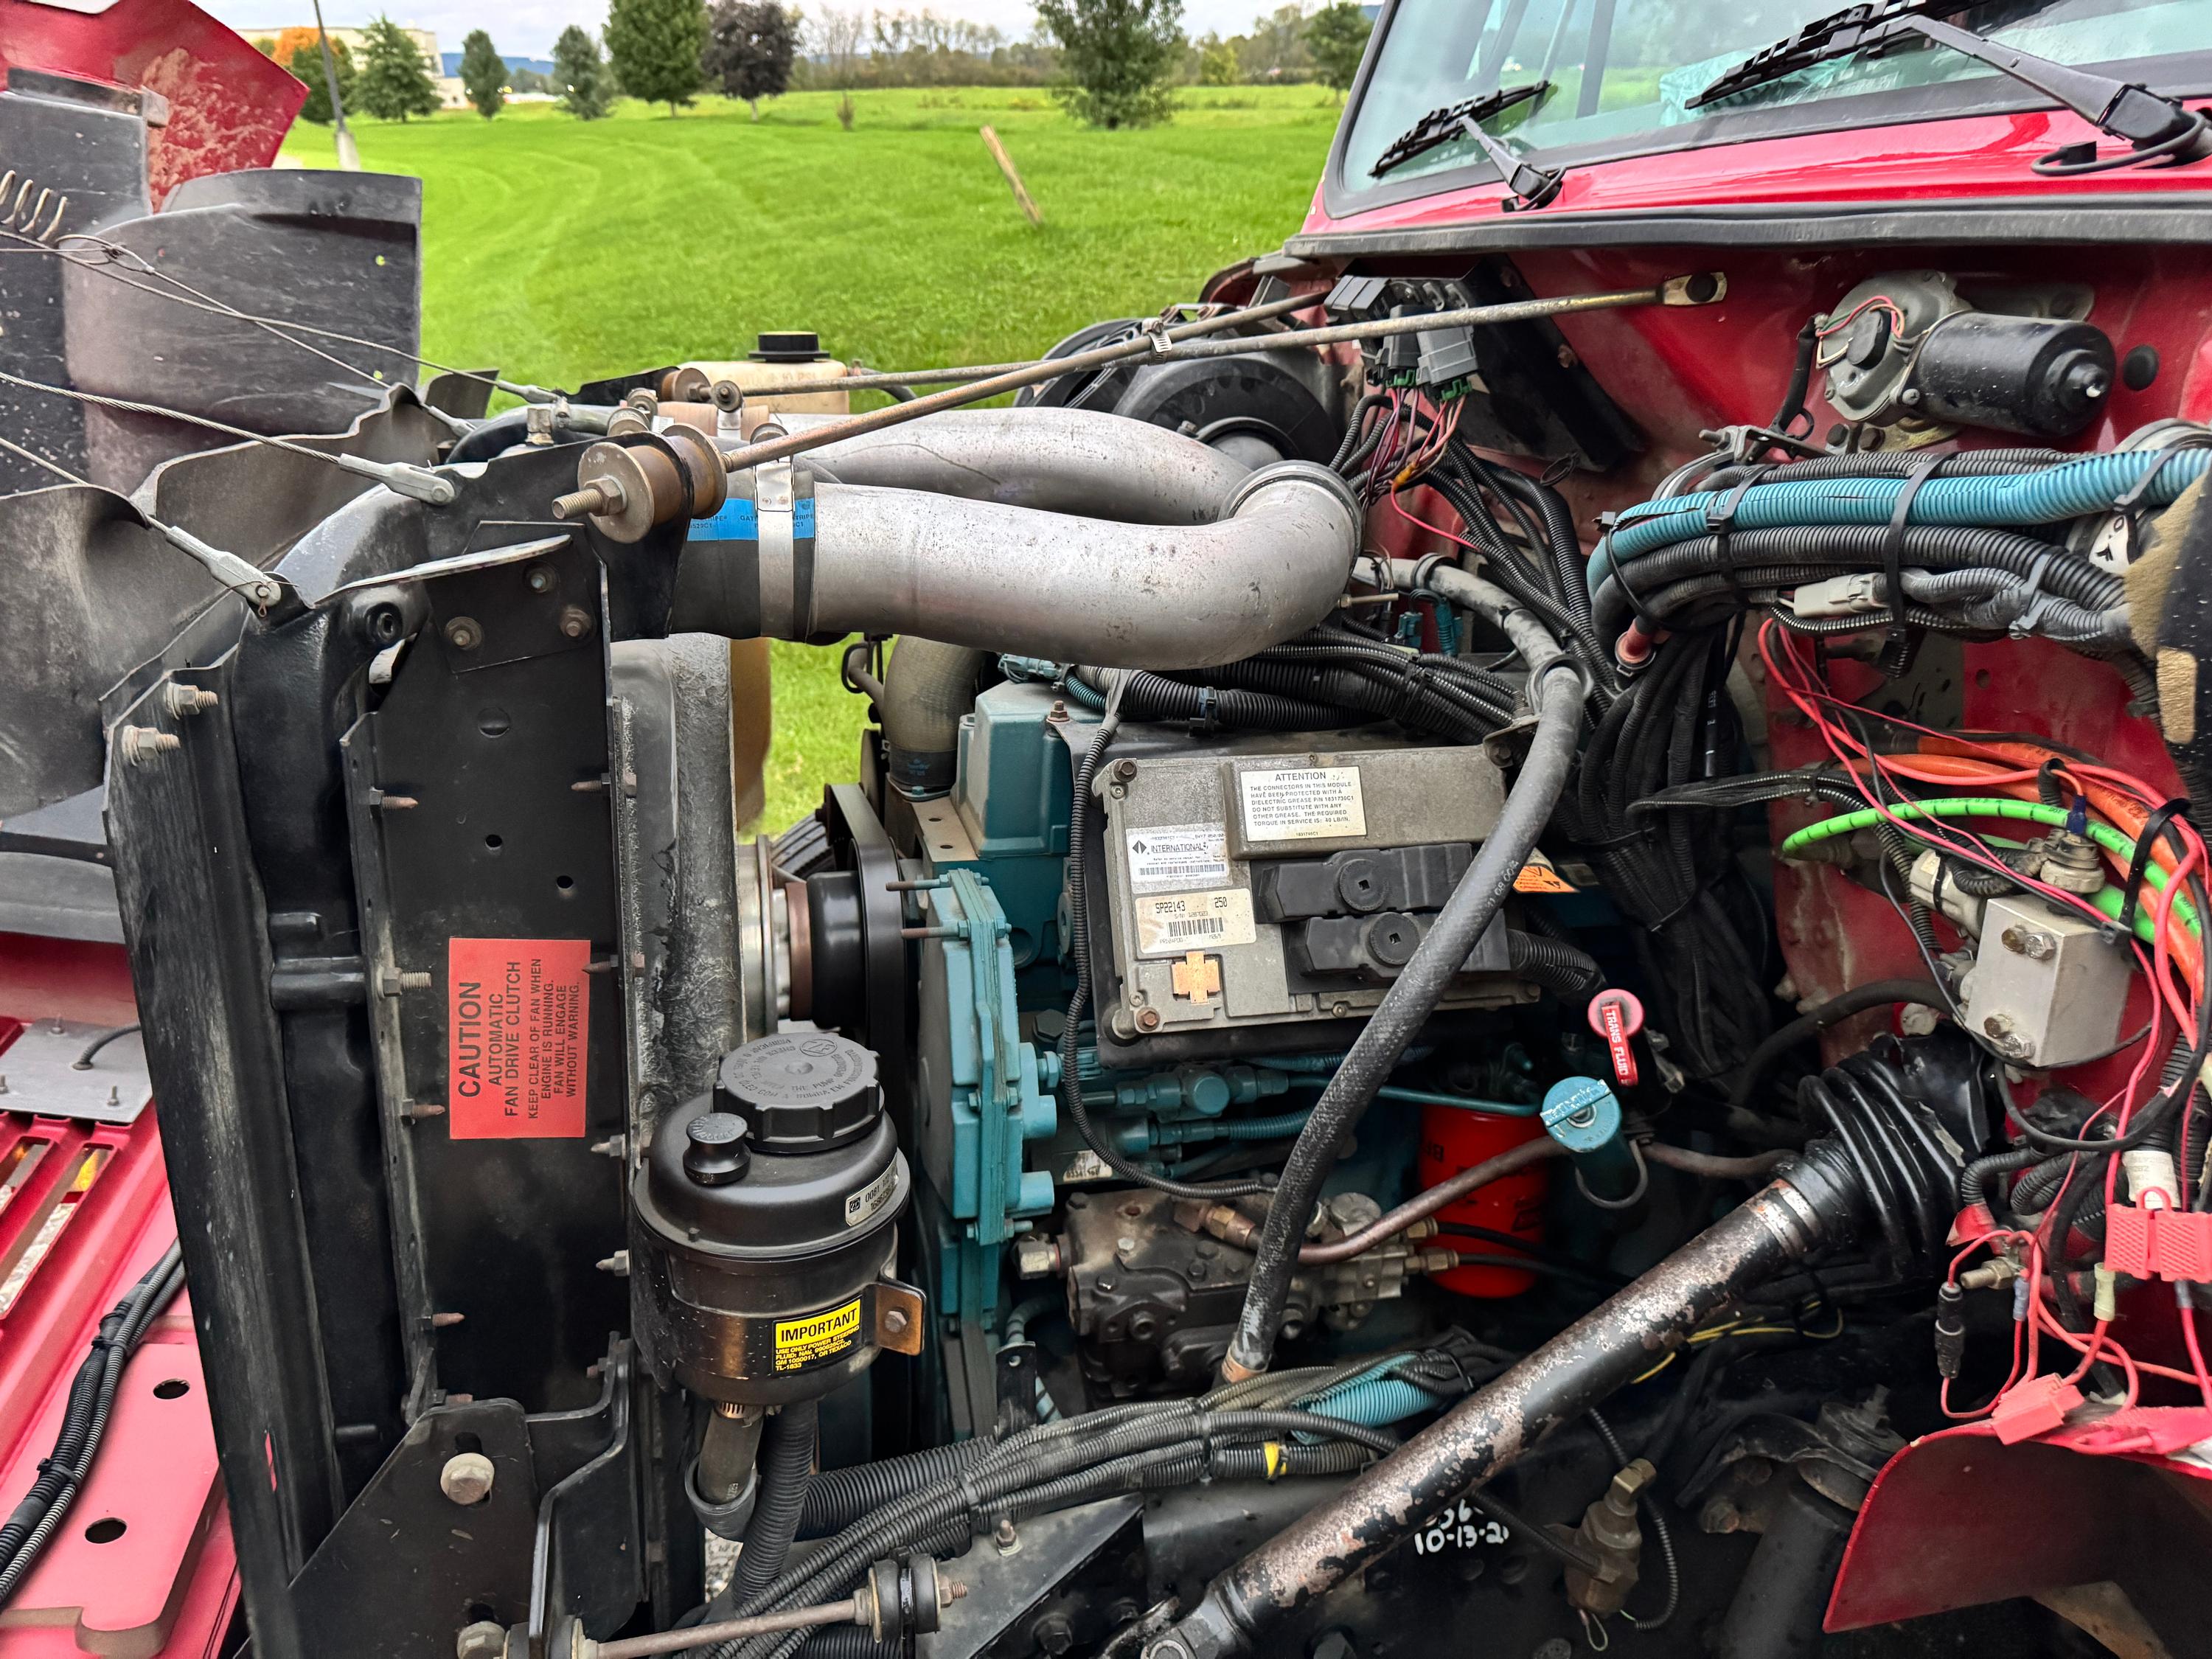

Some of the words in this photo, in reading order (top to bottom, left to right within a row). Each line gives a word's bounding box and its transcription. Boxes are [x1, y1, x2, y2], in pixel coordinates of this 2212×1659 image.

[1275, 772, 1326, 781] ATTENTION
[1151, 843, 1203, 852] INTERNATIONAL
[1155, 900, 1186, 914] SP22143
[1214, 897, 1228, 908] 250
[531, 959, 541, 994] WHEN
[507, 961, 521, 1026] CLUTCH
[543, 979, 554, 1037] RUNNING.
[531, 998, 541, 1021] FAN
[556, 985, 567, 1036] ENGAGE
[568, 981, 580, 1042] WARNING.
[459, 982, 481, 1097] CAUTION
[488, 993, 503, 1086] AUTOMATIC
[530, 1024, 541, 1041] OF
[1606, 1010, 1622, 1043] TRANS
[506, 1032, 520, 1079] DRIVE
[543, 1041, 552, 1053] IS
[555, 1040, 565, 1066] WILL
[1613, 1046, 1629, 1075] FLUID
[529, 1046, 539, 1088] CLEAR
[541, 1056, 552, 1099] ENGINE
[566, 1044, 577, 1097] WITHOUT
[554, 1071, 564, 1094] FAN
[504, 1086, 519, 1116] FAN
[528, 1089, 538, 1119] KEEP
[782, 1308, 857, 1342] IMPORTANT
[808, 1339, 831, 1349] POWER
[832, 1325, 860, 1342] STEERING
[830, 1340, 852, 1354] TEXACO
[776, 1363, 801, 1371] TL-1833
